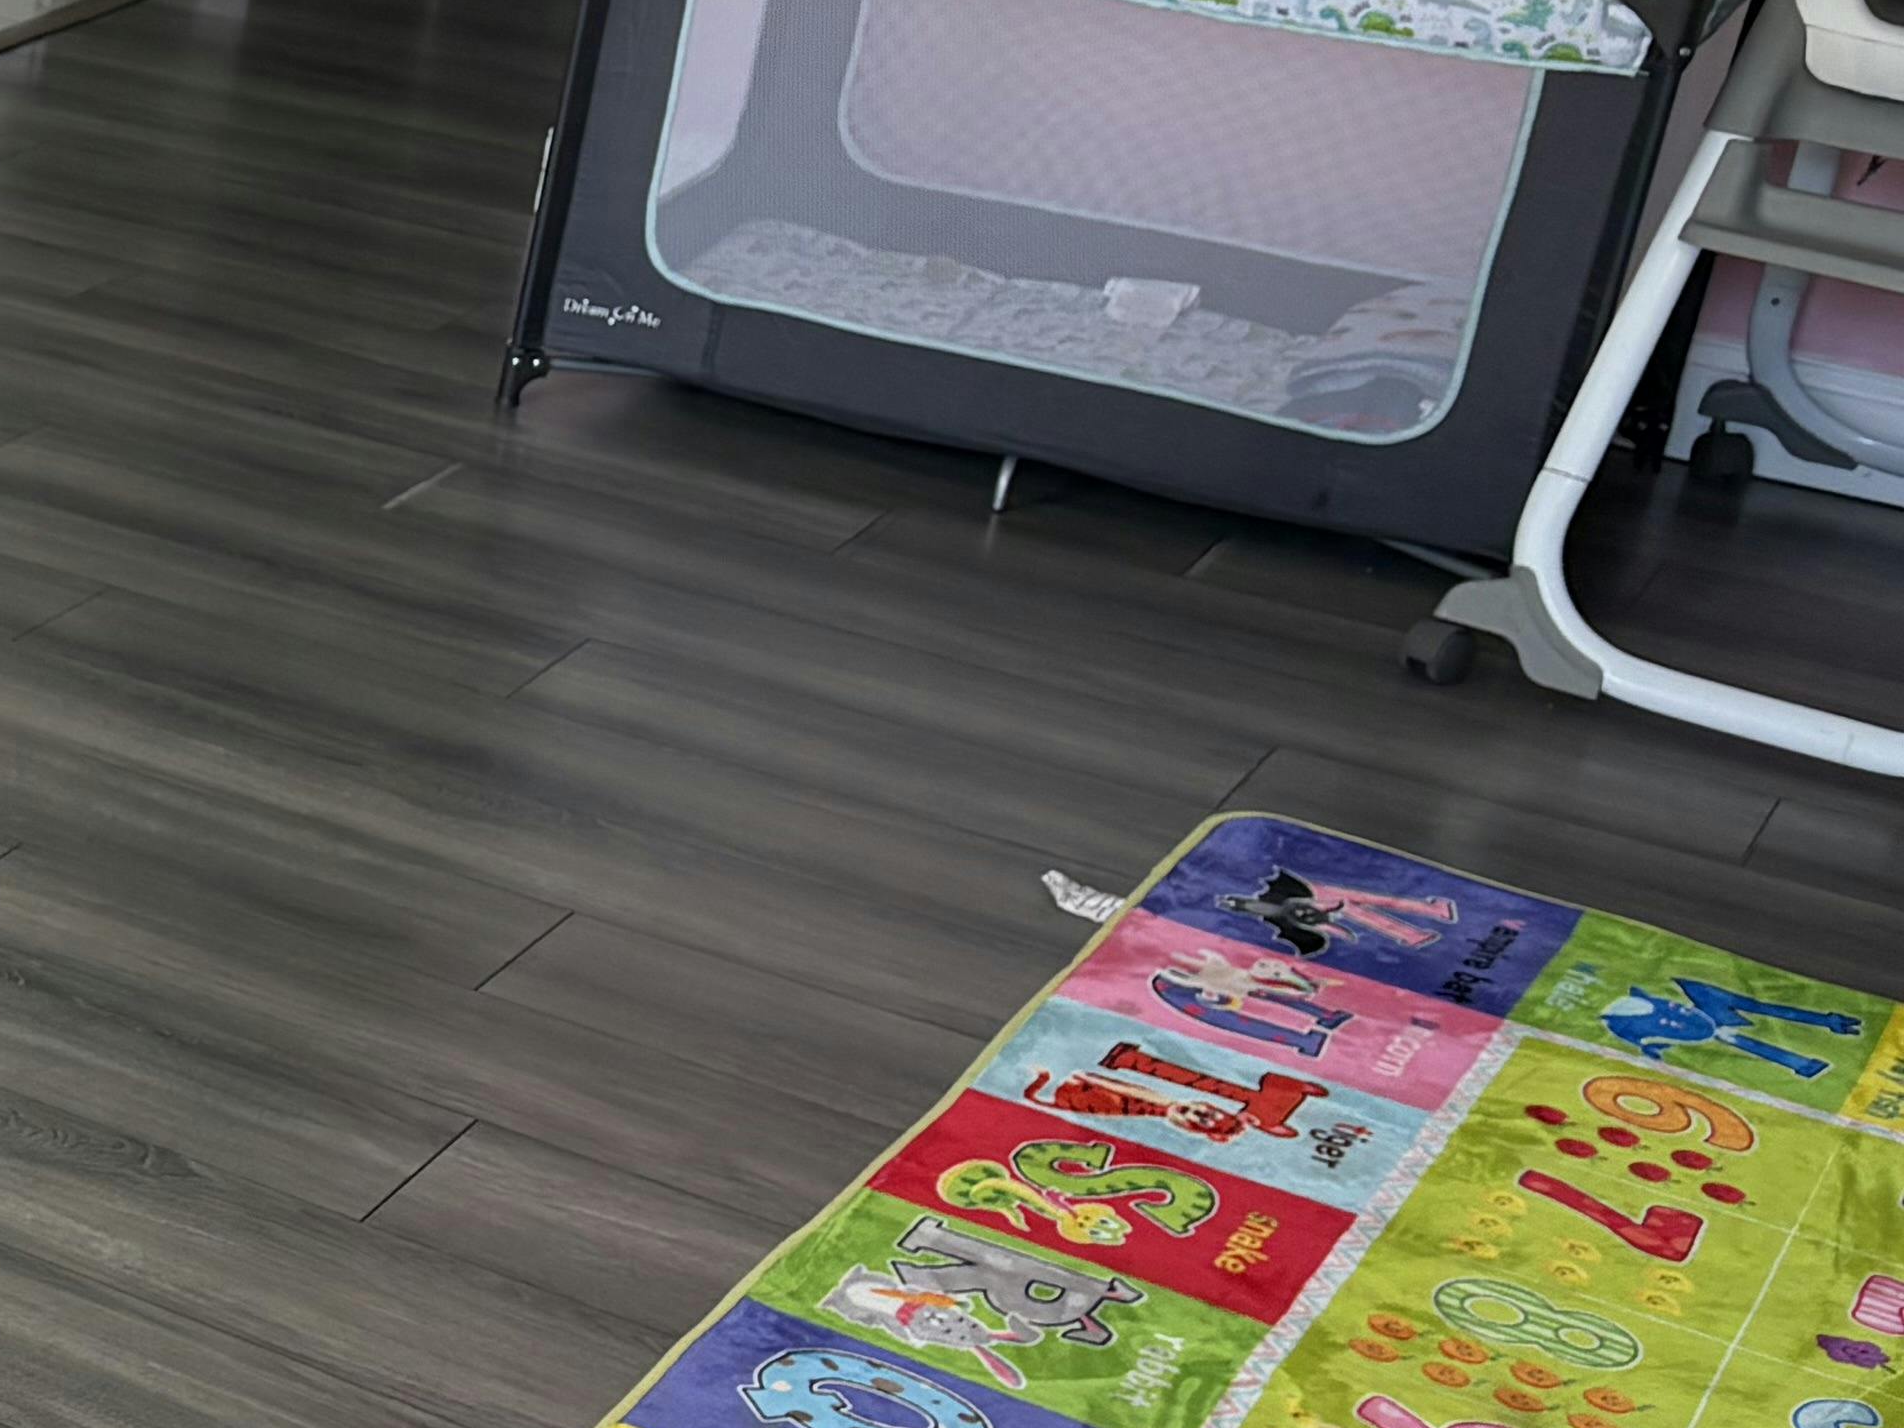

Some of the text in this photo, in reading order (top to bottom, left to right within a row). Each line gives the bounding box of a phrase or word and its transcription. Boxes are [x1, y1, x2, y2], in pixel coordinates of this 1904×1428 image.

[1310, 1120, 1374, 1170] tiger
[1010, 1140, 1279, 1274] S snake
[1515, 1168, 1707, 1266] 7
[892, 1217, 1144, 1345] R
[1434, 1277, 1642, 1370] 8
